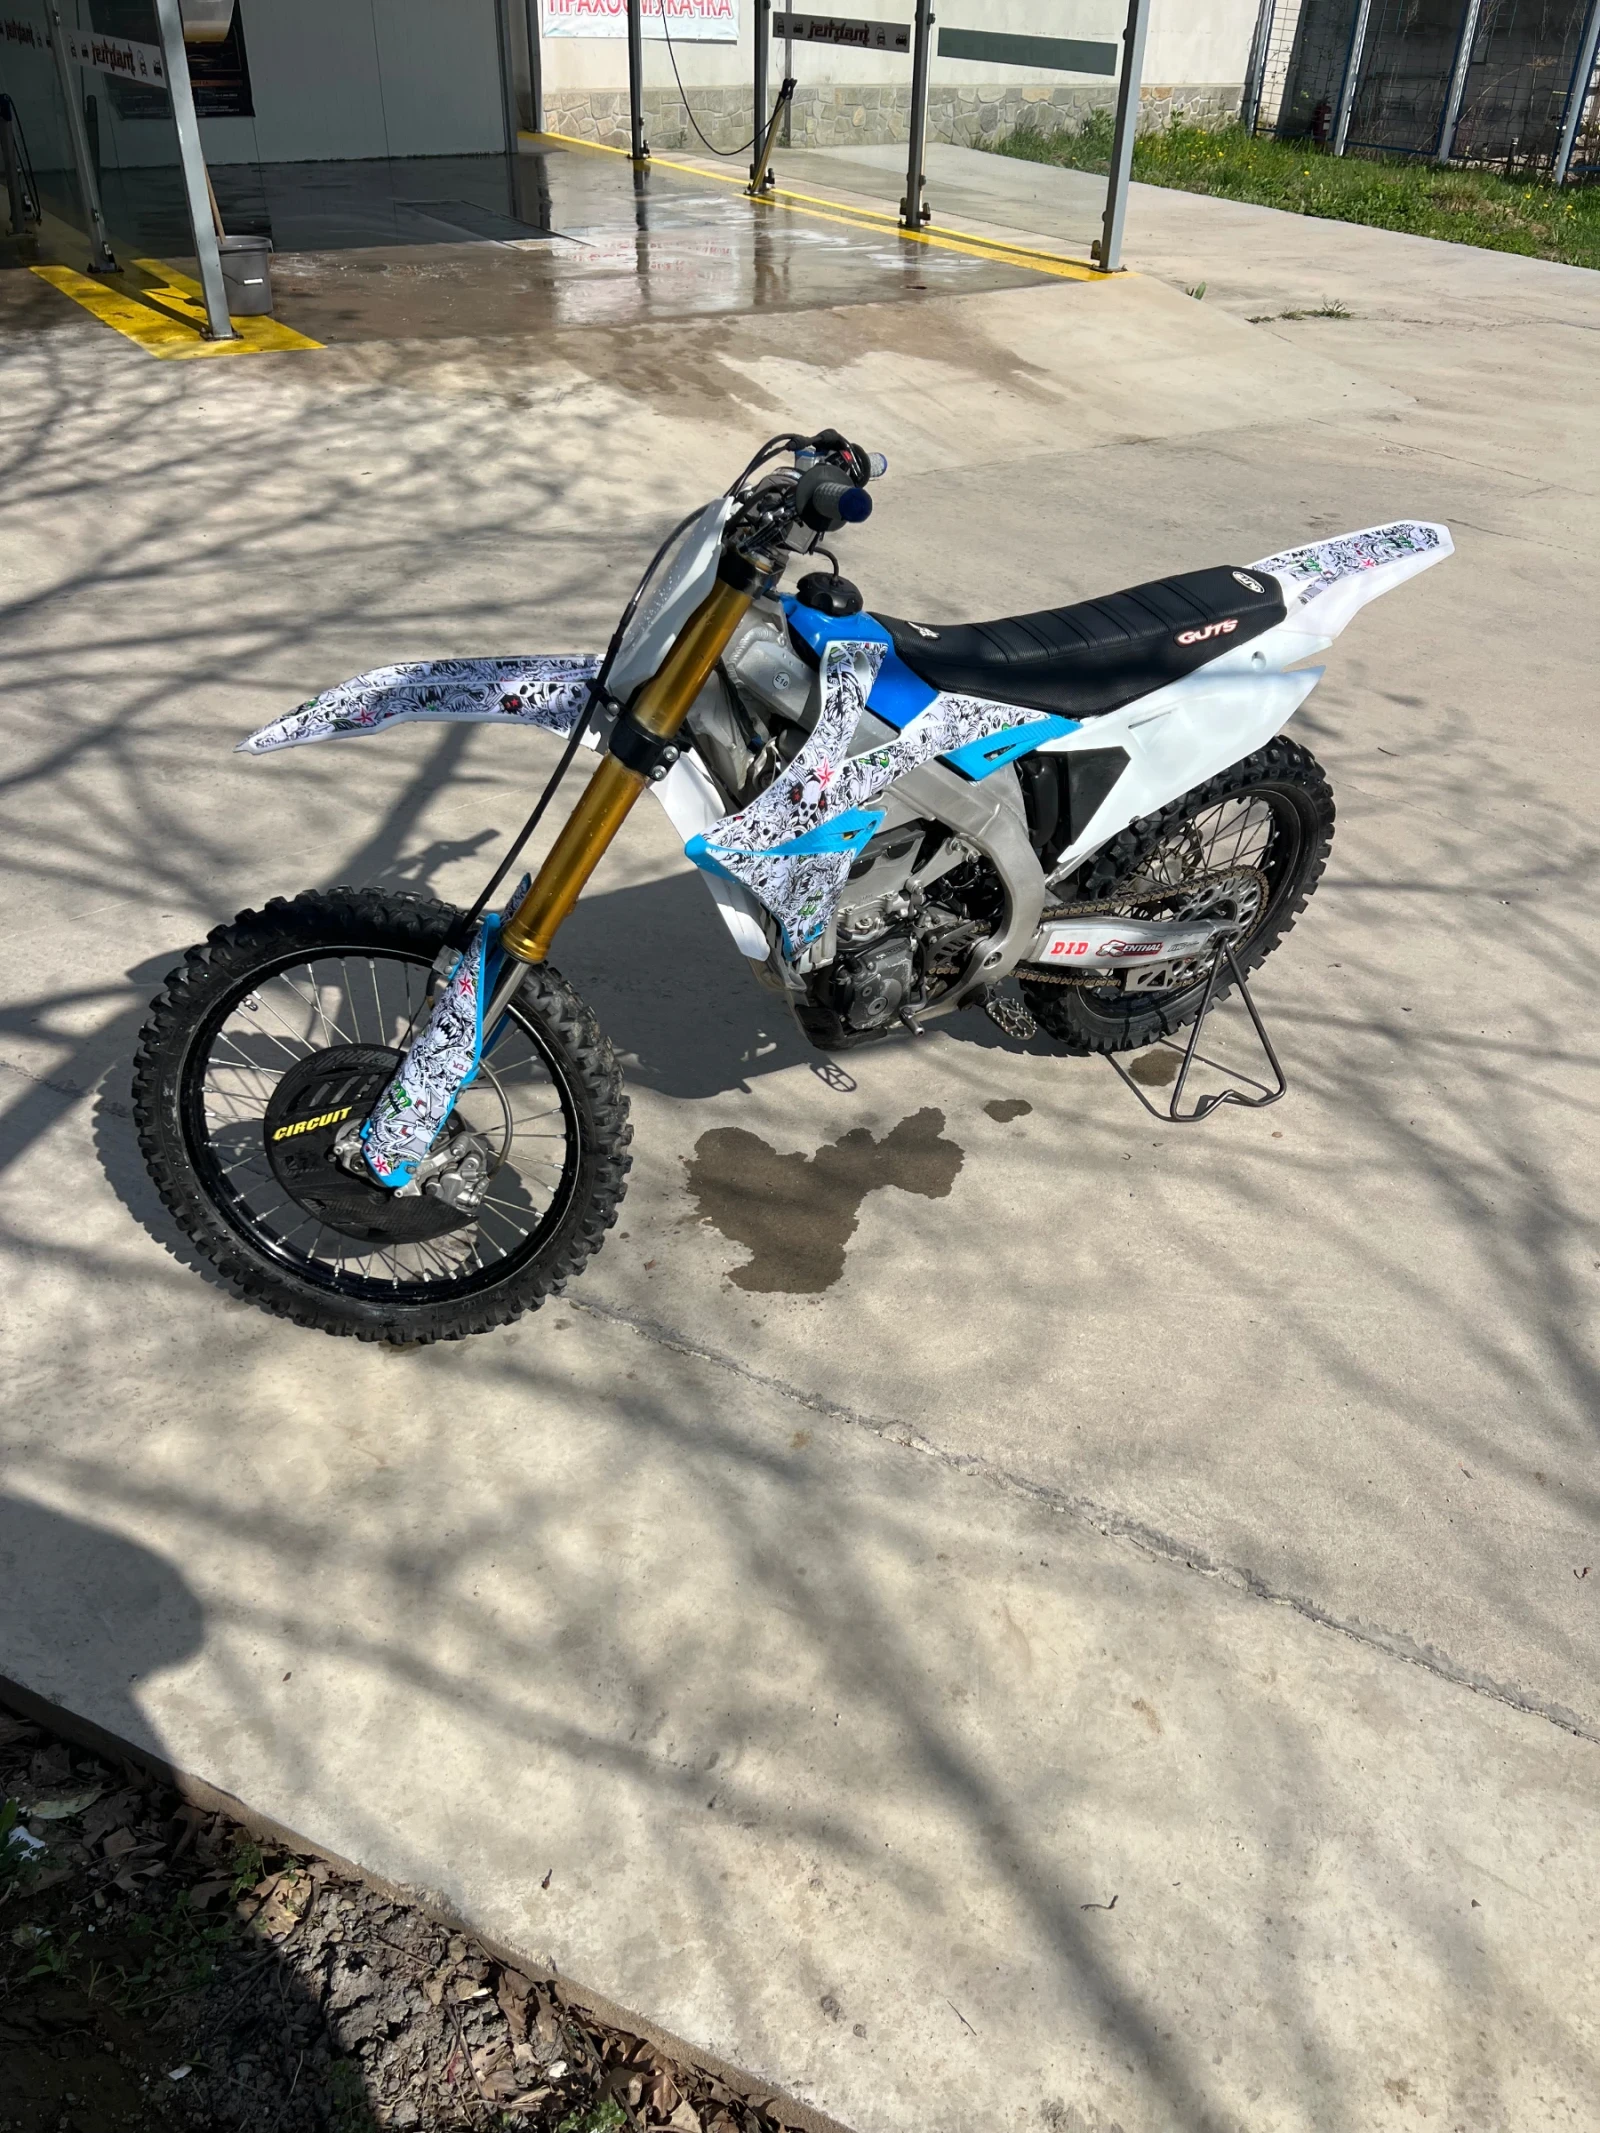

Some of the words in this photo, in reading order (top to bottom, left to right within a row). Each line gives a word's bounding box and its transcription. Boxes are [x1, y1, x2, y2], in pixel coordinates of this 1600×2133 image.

[1177, 618, 1239, 645] GUTS
[774, 674, 789, 688] E10
[1050, 941, 1089, 955] DID
[272, 1105, 353, 1141] CIRCUIT
